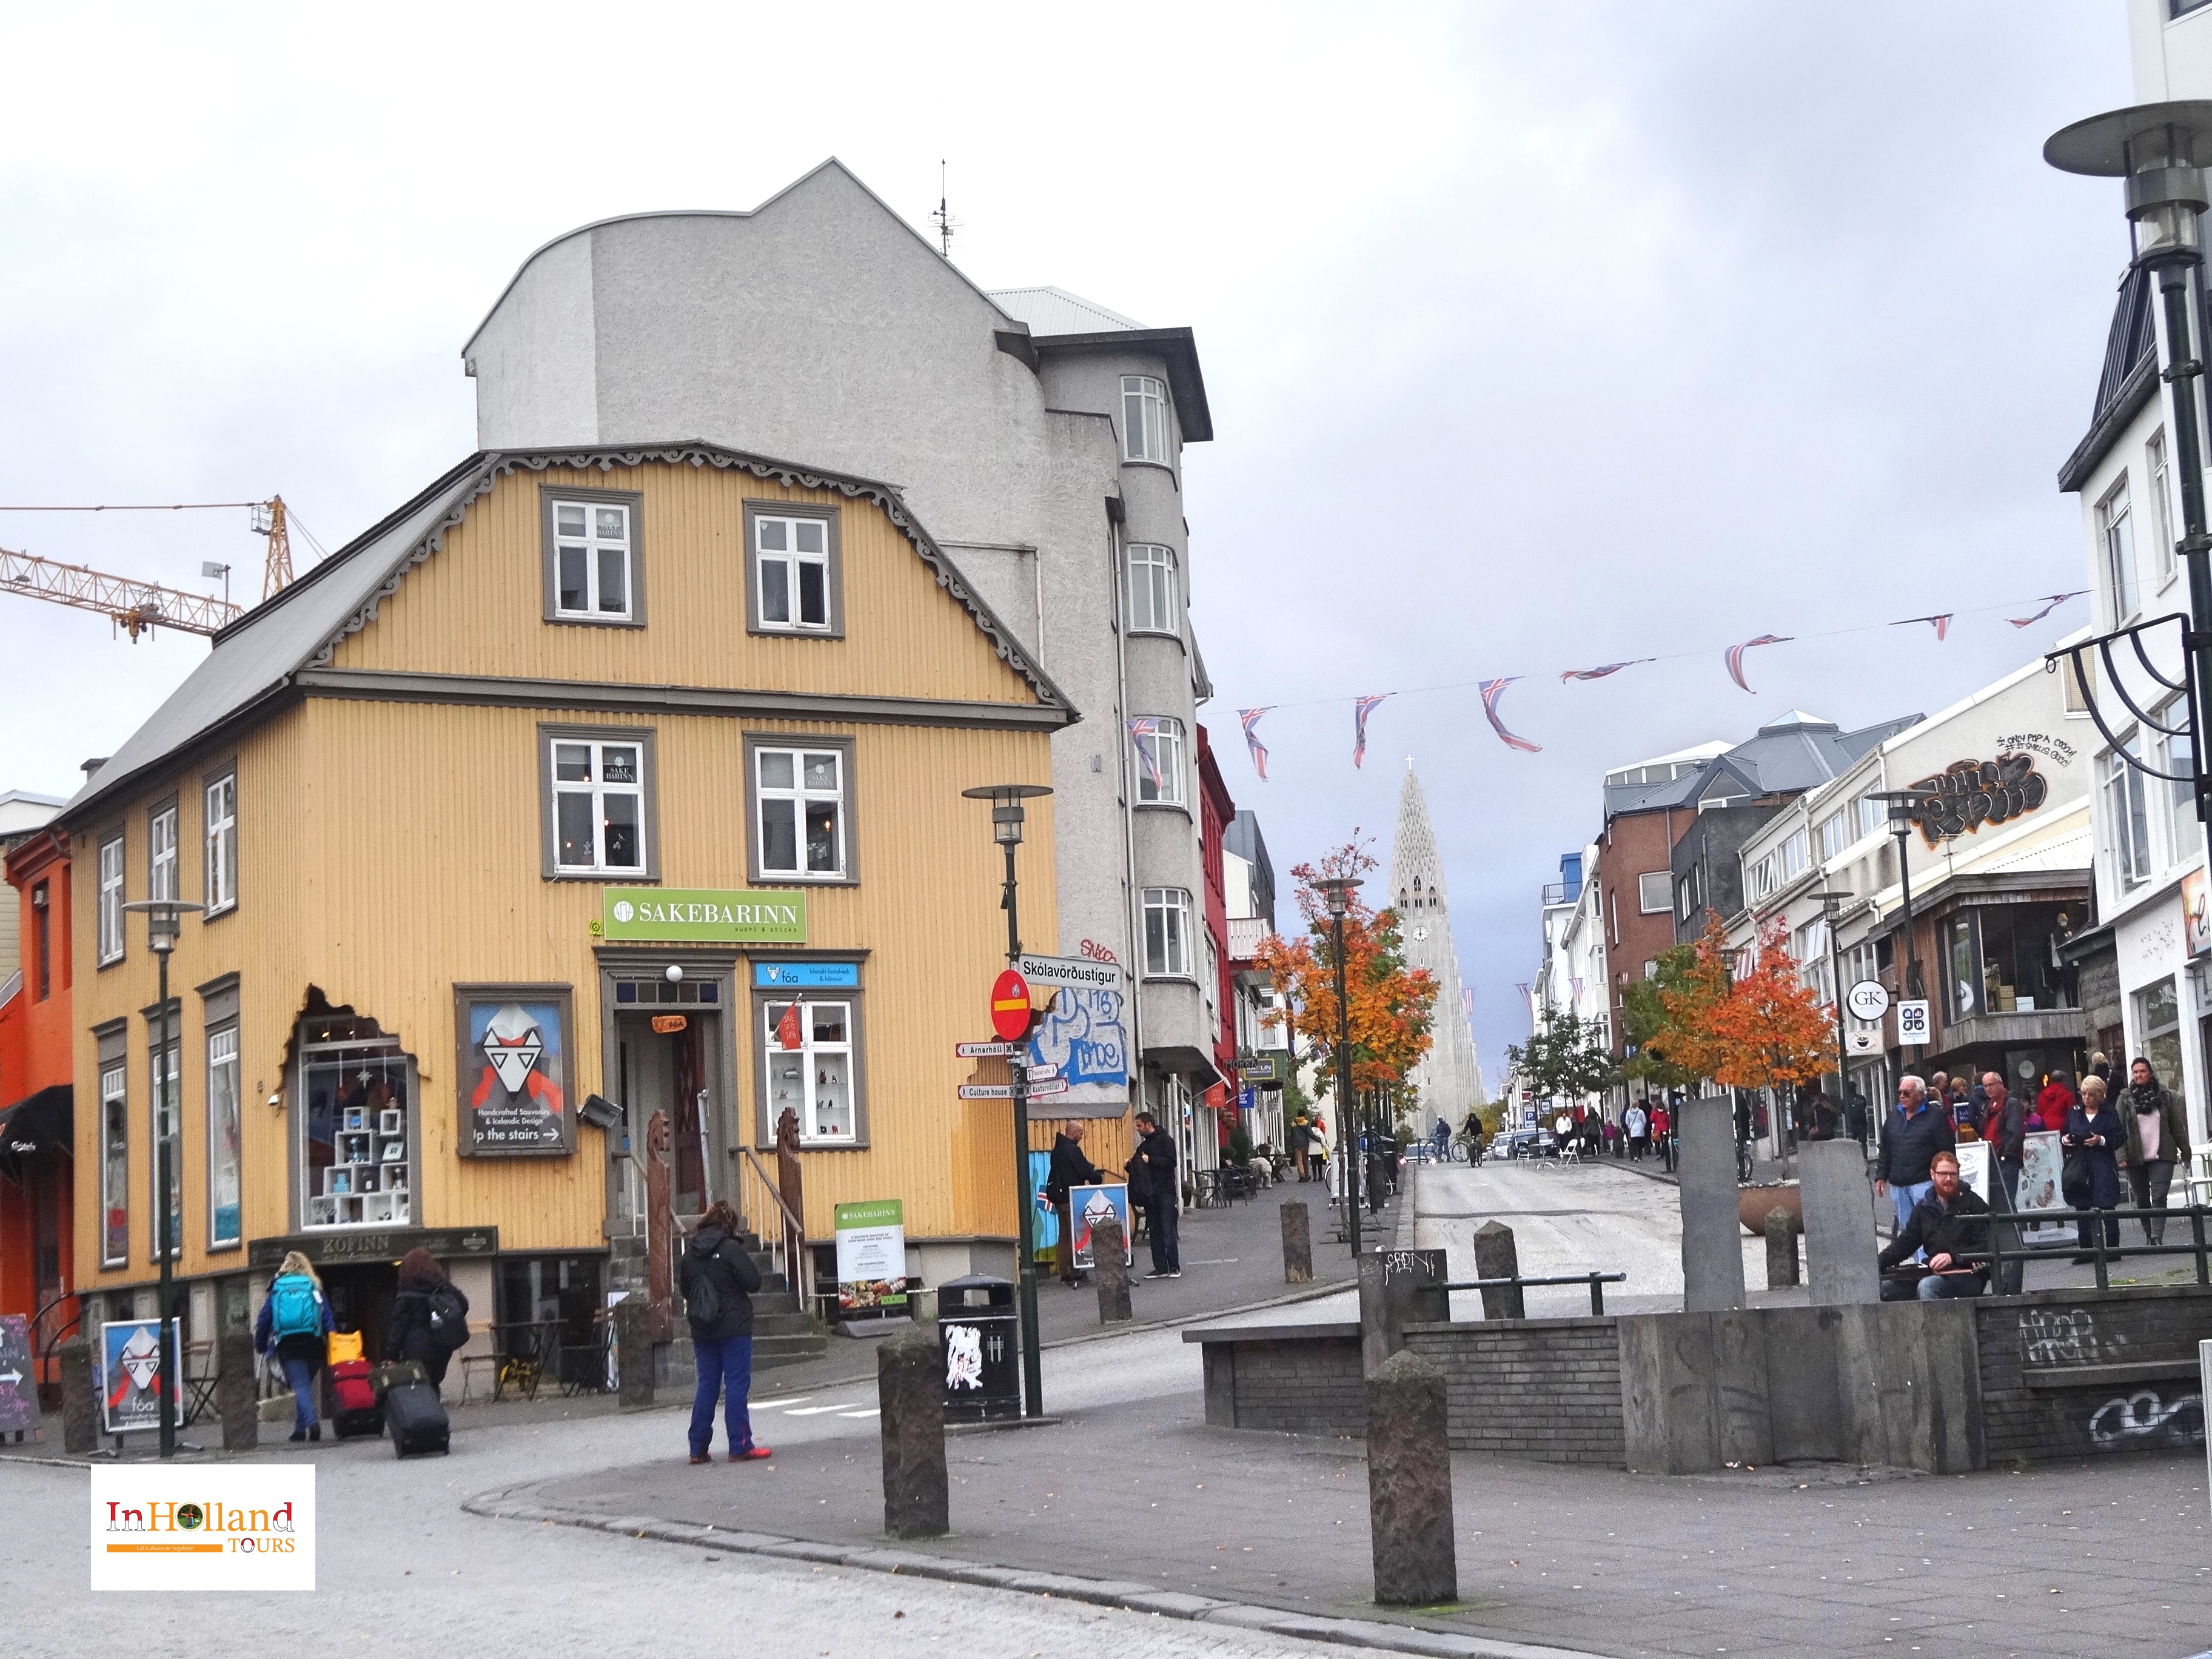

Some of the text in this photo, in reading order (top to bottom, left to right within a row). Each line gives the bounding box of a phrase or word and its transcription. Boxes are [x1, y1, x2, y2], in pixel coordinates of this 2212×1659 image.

[2007, 734, 2025, 743] ONLY
[2027, 734, 2043, 743] POP
[2043, 735, 2050, 743] A
[2026, 742, 2050, 755] SMELLS
[639, 902, 798, 924] SAKEBARINN
[782, 970, 799, 983] fóa
[1024, 961, 1116, 986] Skólavörðustígur
[1855, 991, 1883, 1005] GK
[970, 1042, 1002, 1053] Arnarhóll
[478, 1108, 517, 1116] Handcrafted
[521, 1118, 543, 1126] Design
[487, 1127, 506, 1141] the
[509, 1128, 539, 1141] stairs
[132, 1396, 155, 1412] fóa
